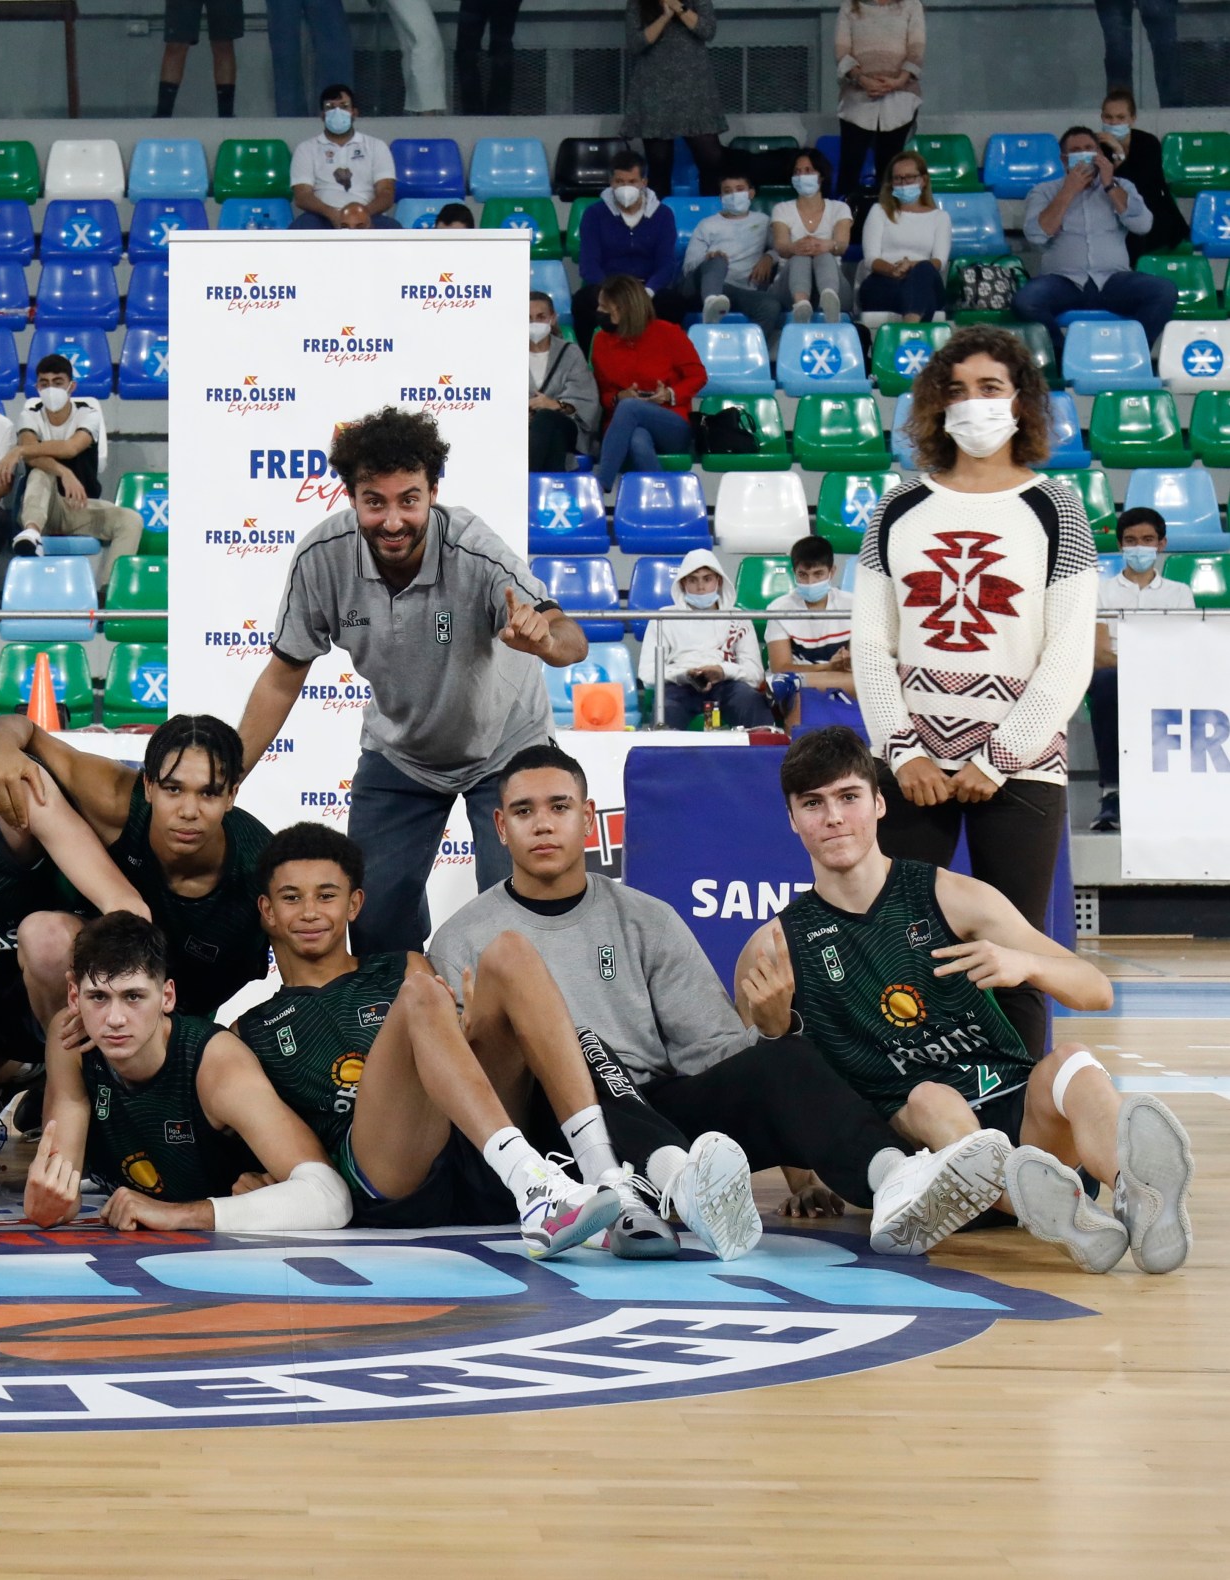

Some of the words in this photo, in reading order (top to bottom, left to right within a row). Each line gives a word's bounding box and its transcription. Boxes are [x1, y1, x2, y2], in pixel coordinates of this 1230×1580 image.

[206, 285, 296, 300] FRED.OLSEN
[401, 284, 492, 299] FRED.OLSEN
[227, 298, 280, 314] Express
[422, 298, 476, 314] Express
[303, 338, 394, 352] FRED.OLSEN
[324, 350, 378, 366] Express
[206, 388, 296, 402] FRED.OLSEN
[400, 387, 491, 401] FRED.OLSEN
[227, 400, 280, 416] Express
[422, 400, 476, 416] Express
[205, 530, 295, 544] FRED.OLSEN
[226, 542, 280, 559] Express
[205, 632, 275, 646] FRED.OLS
[302, 686, 372, 700] FRED.OLS
[1151, 708, 1230, 773] FR
[301, 792, 352, 806] FRED.O
[806, 924, 839, 942] SPALDING
